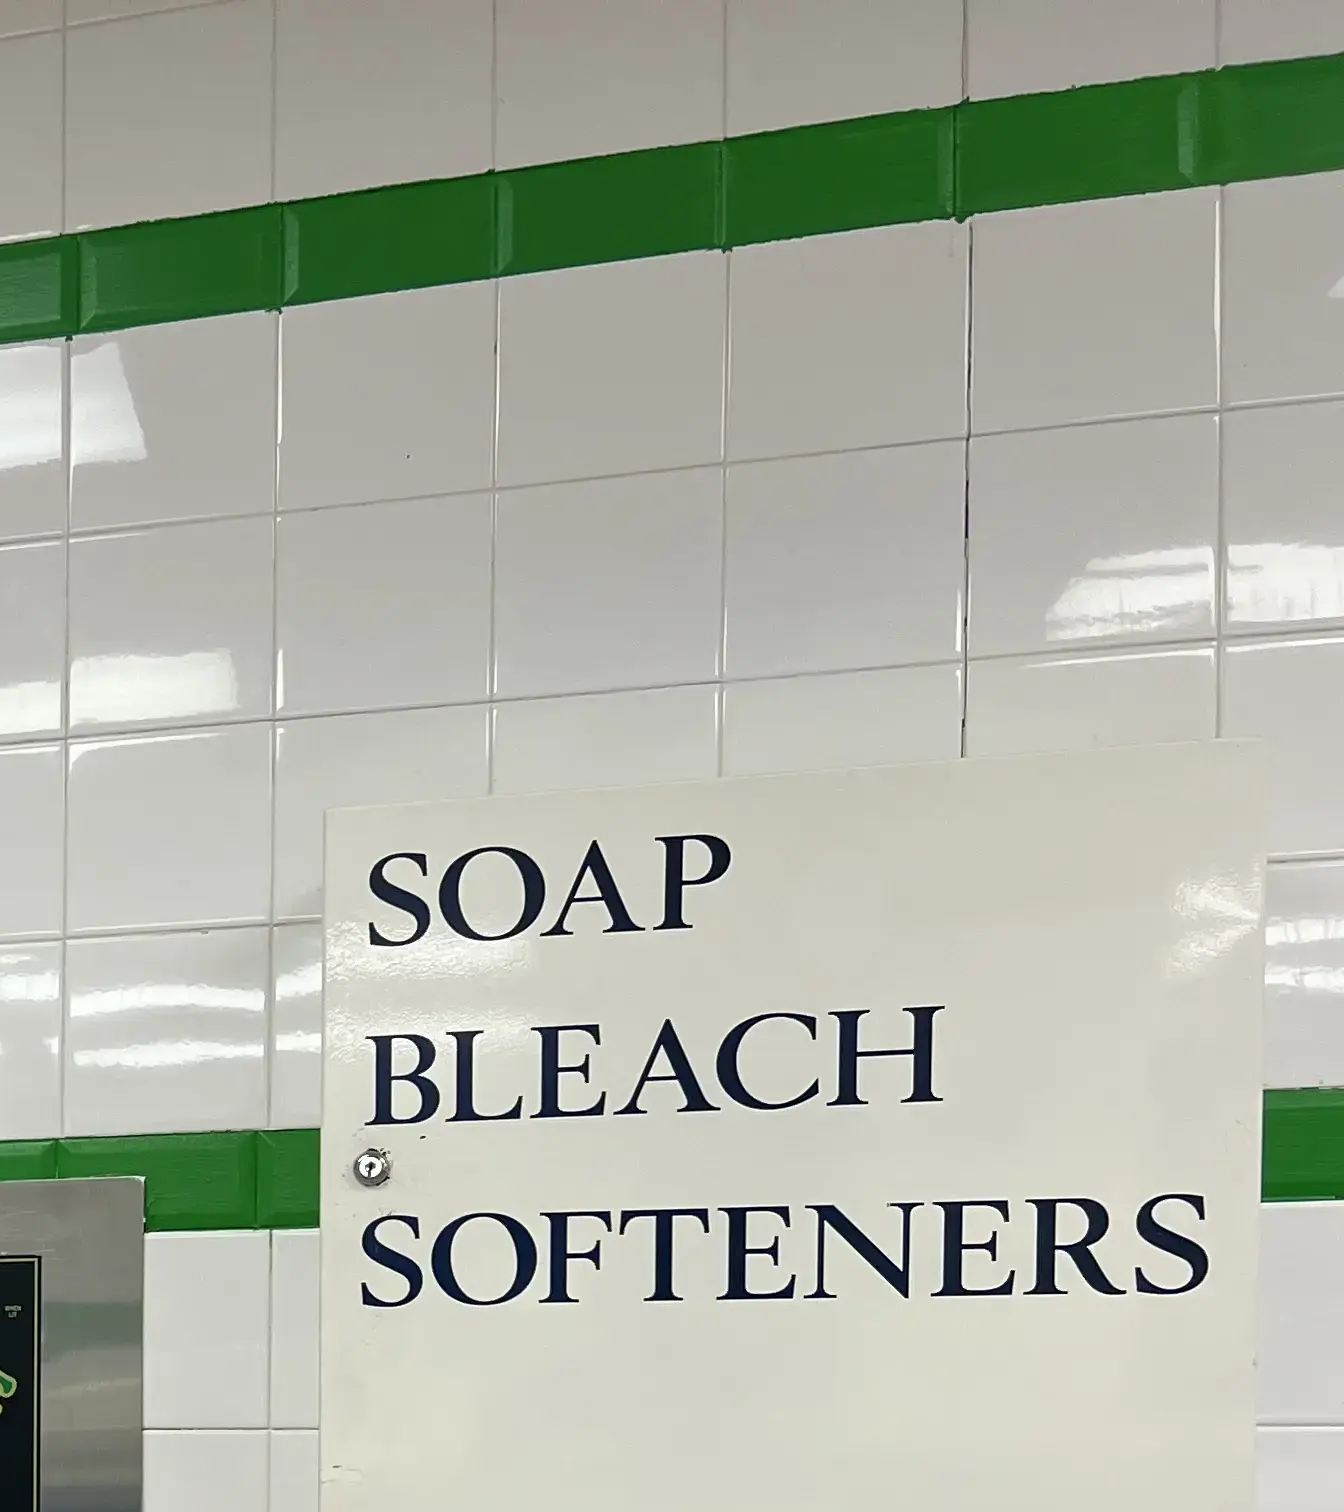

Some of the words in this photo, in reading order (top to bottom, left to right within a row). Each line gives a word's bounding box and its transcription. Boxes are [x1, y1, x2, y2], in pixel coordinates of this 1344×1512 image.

[367, 832, 732, 948] SOAP
[364, 1004, 946, 1128] BLEACH
[358, 1192, 1210, 1310] SOFTENERS
